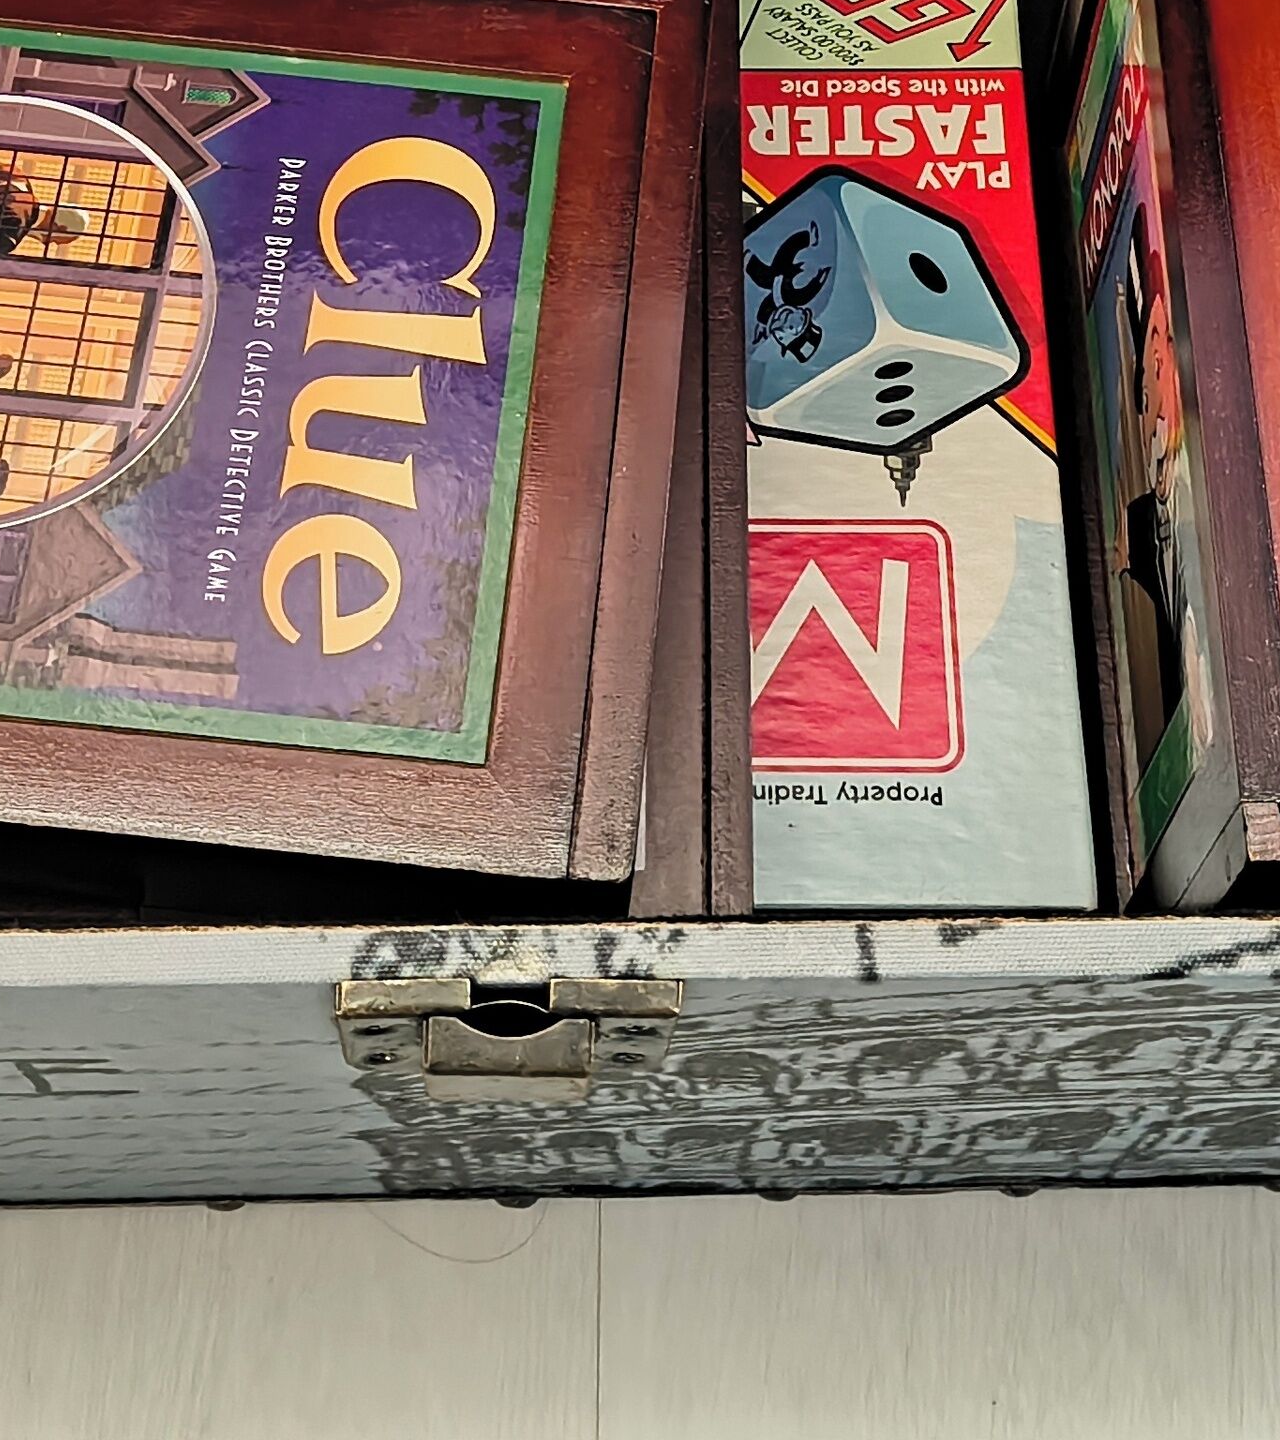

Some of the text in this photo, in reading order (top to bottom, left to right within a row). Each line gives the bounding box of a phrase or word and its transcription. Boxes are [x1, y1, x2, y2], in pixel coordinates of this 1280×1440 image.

[763, 6, 819, 36] SALARY
[795, 3, 880, 52] AS YOU PASS
[765, 27, 824, 61] COLLECT
[780, 75, 1005, 98] with the Speed Die
[746, 103, 1007, 157] FASTER
[916, 161, 1011, 190] PLAY
[262, 136, 497, 656] Clue
[753, 780, 944, 806] Property Tradin
